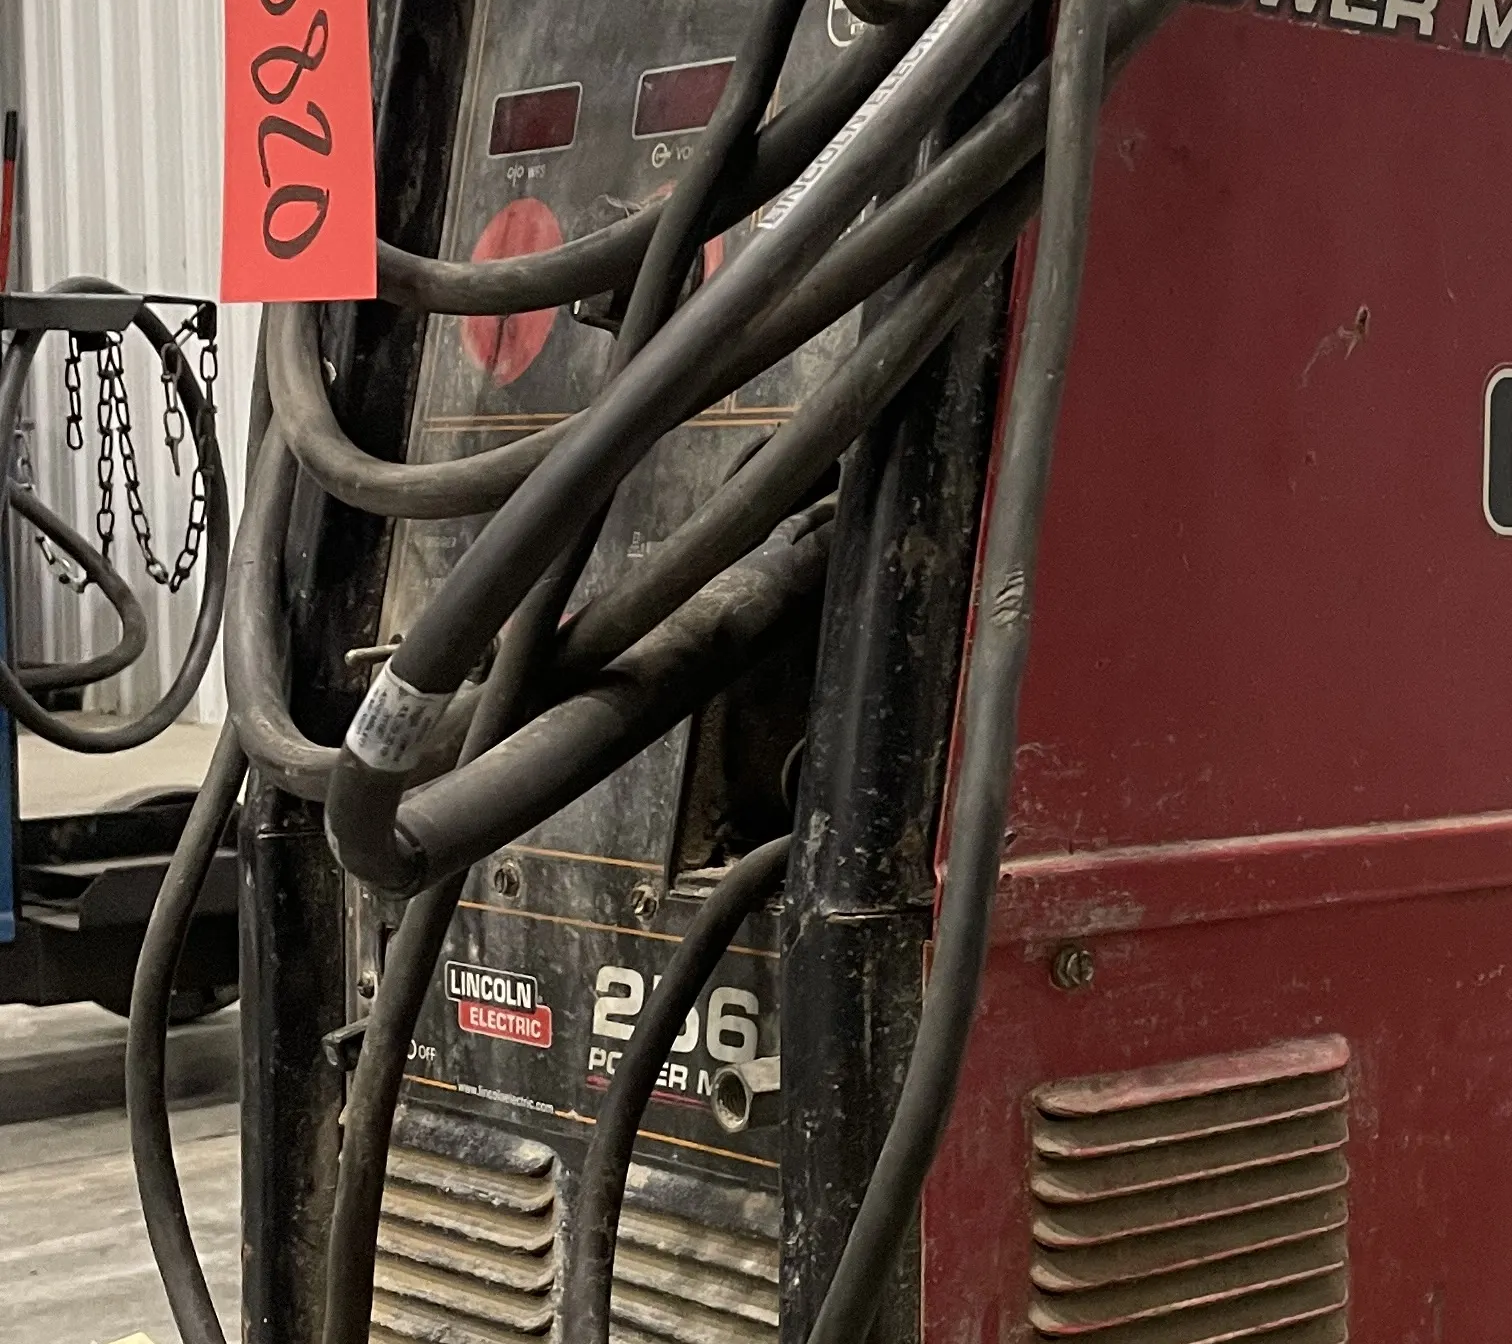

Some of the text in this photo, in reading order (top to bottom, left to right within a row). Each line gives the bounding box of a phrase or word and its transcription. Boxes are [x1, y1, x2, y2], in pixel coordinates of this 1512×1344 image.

[760, 114, 868, 226] LINCOLN
[450, 968, 532, 1009] LINCOLN
[469, 1006, 542, 1038] ELECTRIC
[418, 1044, 437, 1061] OFF
